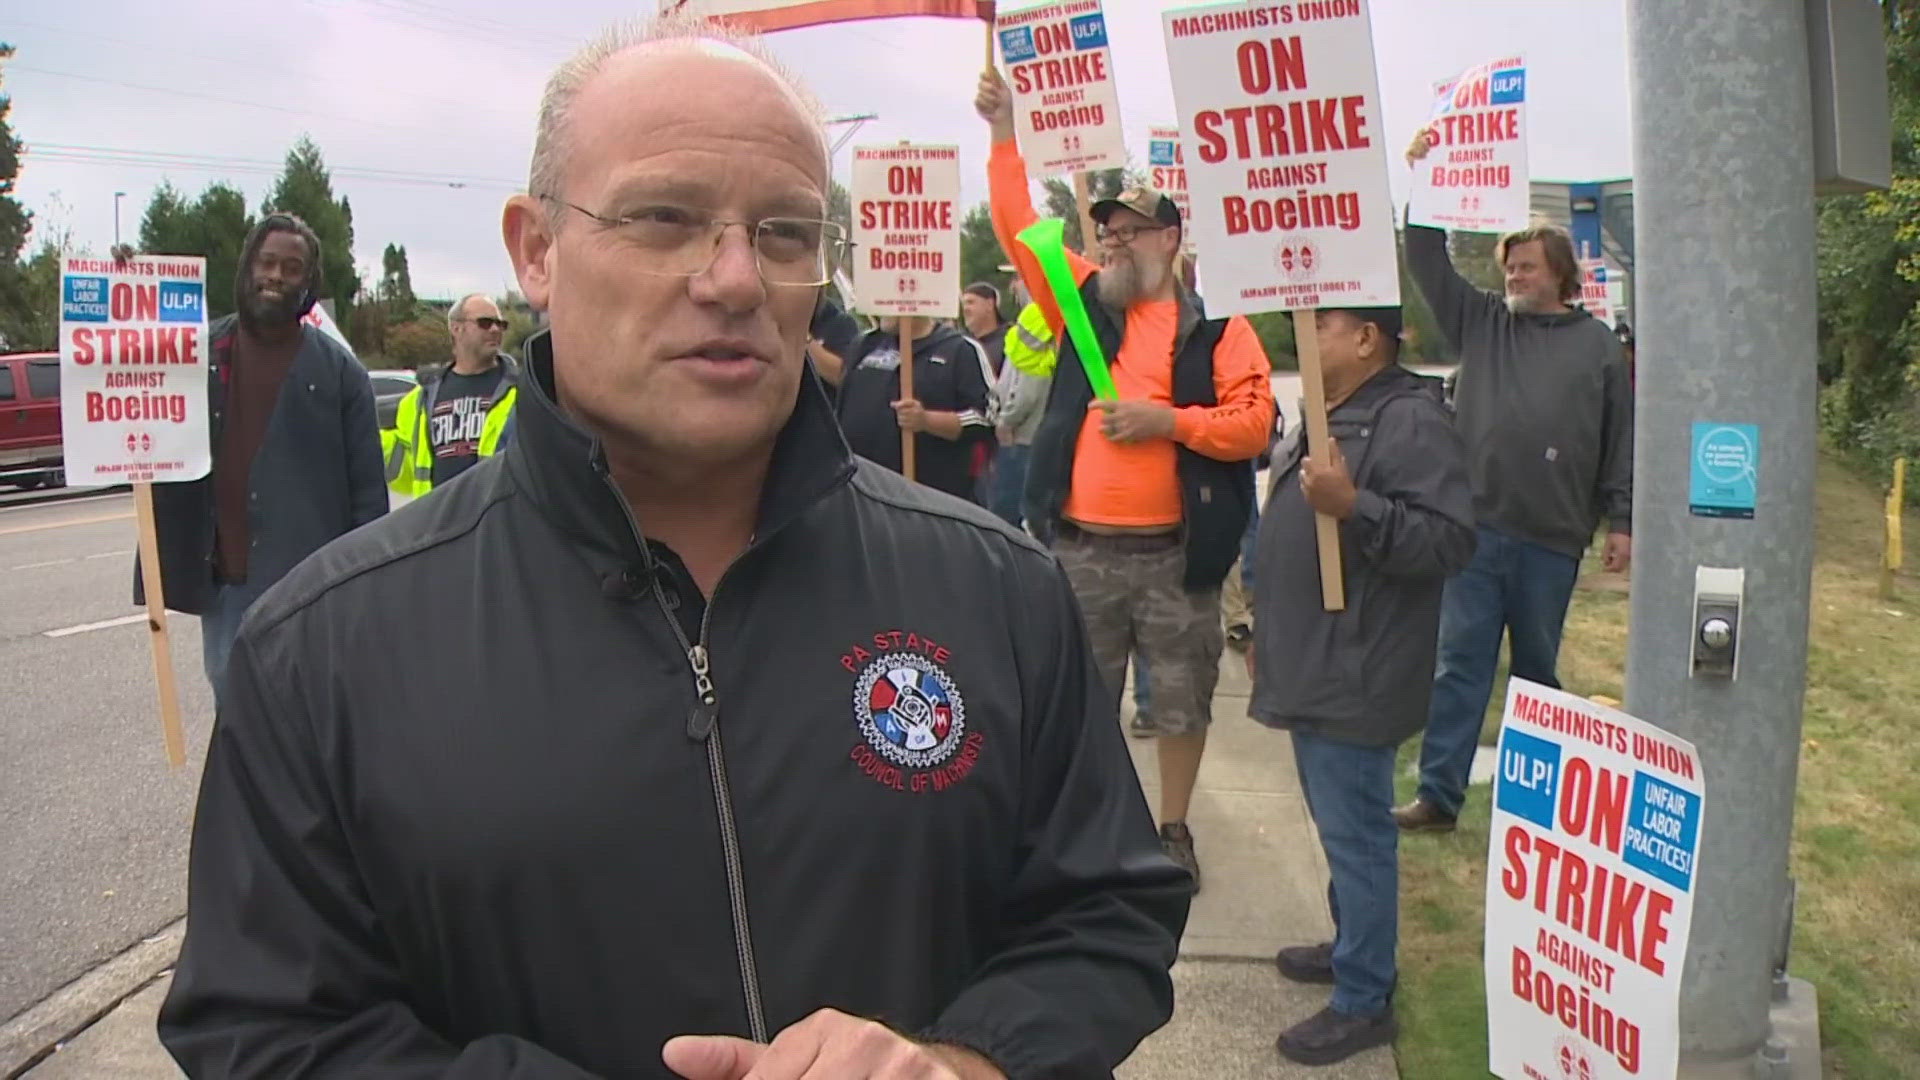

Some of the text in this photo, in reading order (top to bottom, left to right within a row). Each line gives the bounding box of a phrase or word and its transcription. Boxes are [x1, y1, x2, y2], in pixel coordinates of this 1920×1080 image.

[998, 0, 1098, 26] MACHINISTS UNION
[1172, 0, 1360, 37] MACHINISTS UNION
[1033, 21, 1071, 55] ON
[1074, 22, 1102, 38] ULP!
[1012, 52, 1106, 94] STRIKE
[1236, 35, 1307, 96] ON
[1042, 90, 1085, 106] AGAINST
[1454, 78, 1488, 109] ON
[1493, 77, 1522, 93] ULP!
[1030, 104, 1105, 133] Boeing
[1194, 95, 1370, 164] STRIKE
[856, 149, 955, 161] MACHINISTS UNION
[1448, 148, 1494, 163] AGAINST
[887, 165, 923, 195] ON
[1247, 163, 1327, 190] AGAINST
[1431, 163, 1510, 188] Boeing
[859, 200, 952, 231] STRIKE
[1222, 190, 1361, 236] Boeing
[884, 234, 928, 245] AGAINST
[67, 259, 200, 278] MACHINISTS UNION
[870, 248, 943, 273] Boeing
[111, 282, 157, 322] ON
[162, 292, 198, 311] ULP!
[1278, 283, 1317, 295] DISTRICT
[1319, 281, 1345, 292] LODGE
[72, 327, 198, 365] STRIKE
[105, 372, 166, 388] AGAINST
[86, 391, 186, 423] Boeing
[840, 631, 951, 673] PA STATE
[1513, 693, 1694, 781] MACHINISTS UNION
[851, 731, 984, 793] COUNCIL OF MACHINISTS
[1504, 748, 1553, 797] ULP!
[1559, 756, 1629, 855] ON
[1644, 780, 1687, 818] UNFAIR
[1642, 805, 1681, 843] LABOR
[1626, 826, 1692, 875] PRACTICES!
[1502, 825, 1673, 978] STRIKE
[1536, 927, 1615, 994] AGAINST
[1512, 944, 1640, 1074] Boeing
